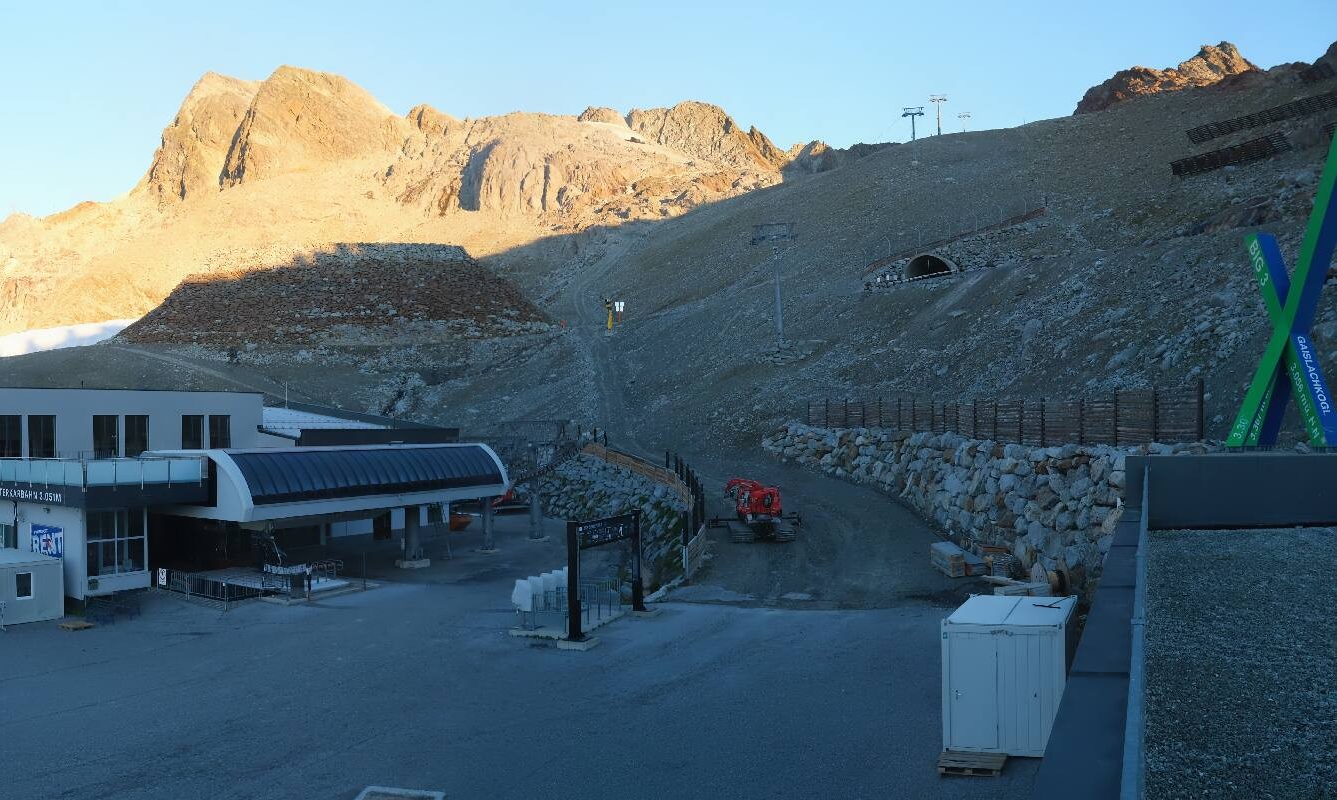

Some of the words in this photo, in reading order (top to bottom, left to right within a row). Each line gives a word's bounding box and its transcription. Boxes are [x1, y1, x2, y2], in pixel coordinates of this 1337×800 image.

[1250, 239, 1264, 272] BIG
[1261, 273, 1269, 286] 3
[1297, 335, 1331, 417] GAISLACHKOGL
[32, 532, 63, 555] RENT
